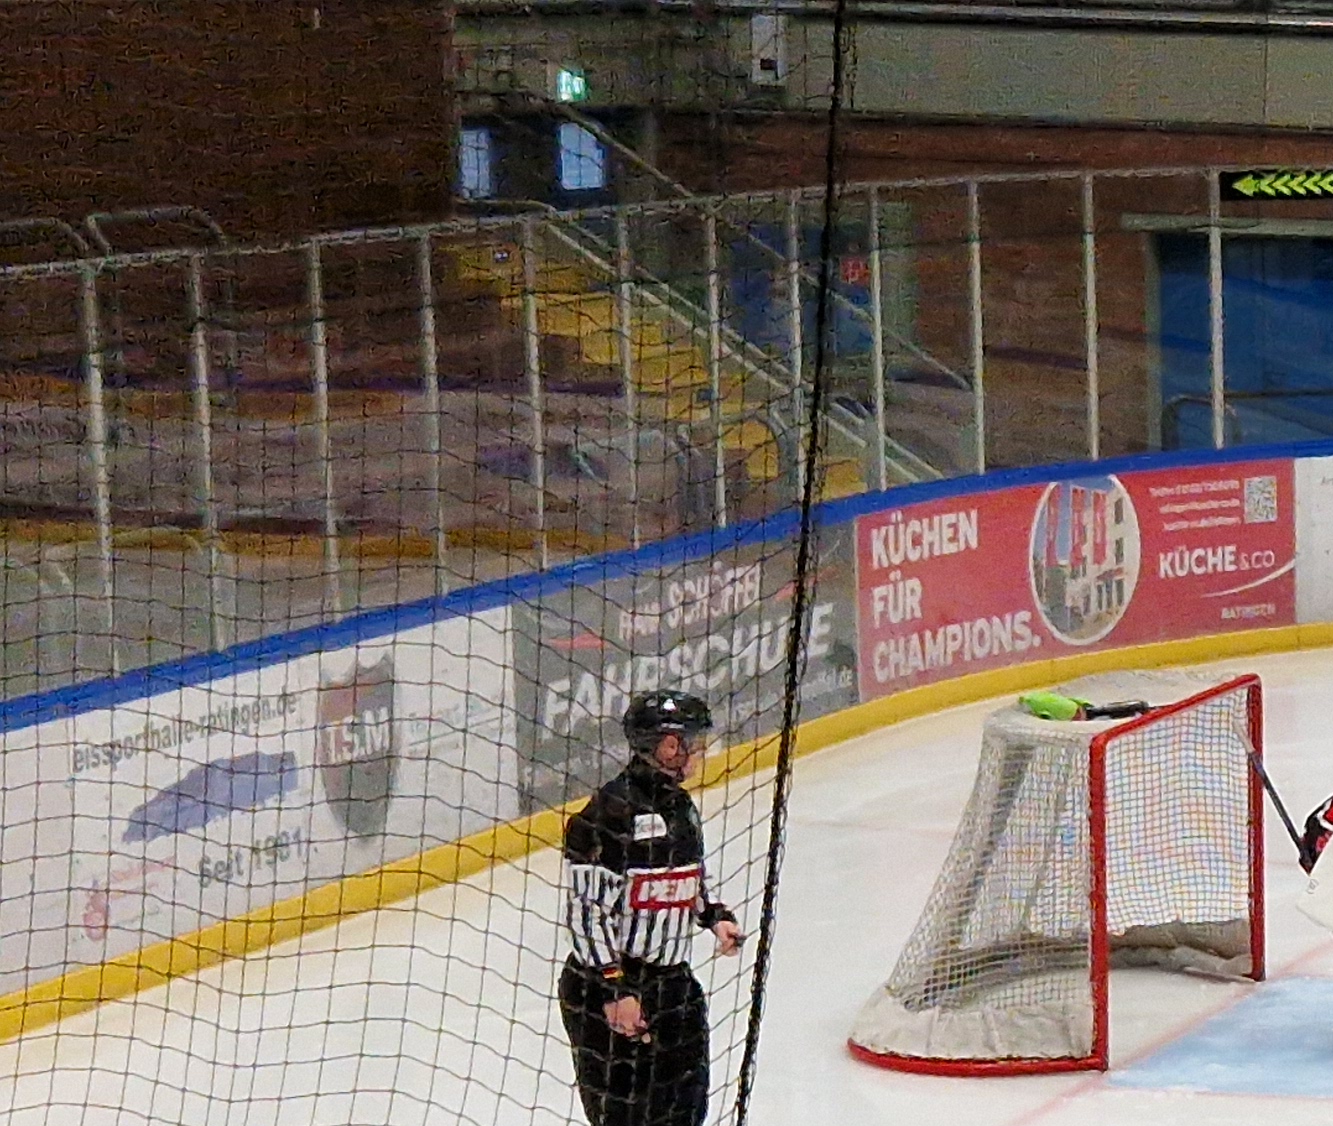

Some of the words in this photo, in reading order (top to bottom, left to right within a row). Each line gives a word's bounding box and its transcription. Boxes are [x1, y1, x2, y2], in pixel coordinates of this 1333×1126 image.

[871, 510, 978, 569] KÜCHEN
[1159, 545, 1237, 579] KÜCHE
[872, 571, 922, 629] FÜR
[873, 611, 1040, 683] CHAMPIONS.
[72, 692, 299, 774] eissporthalle-ratingen.de
[199, 853, 243, 887] Seit
